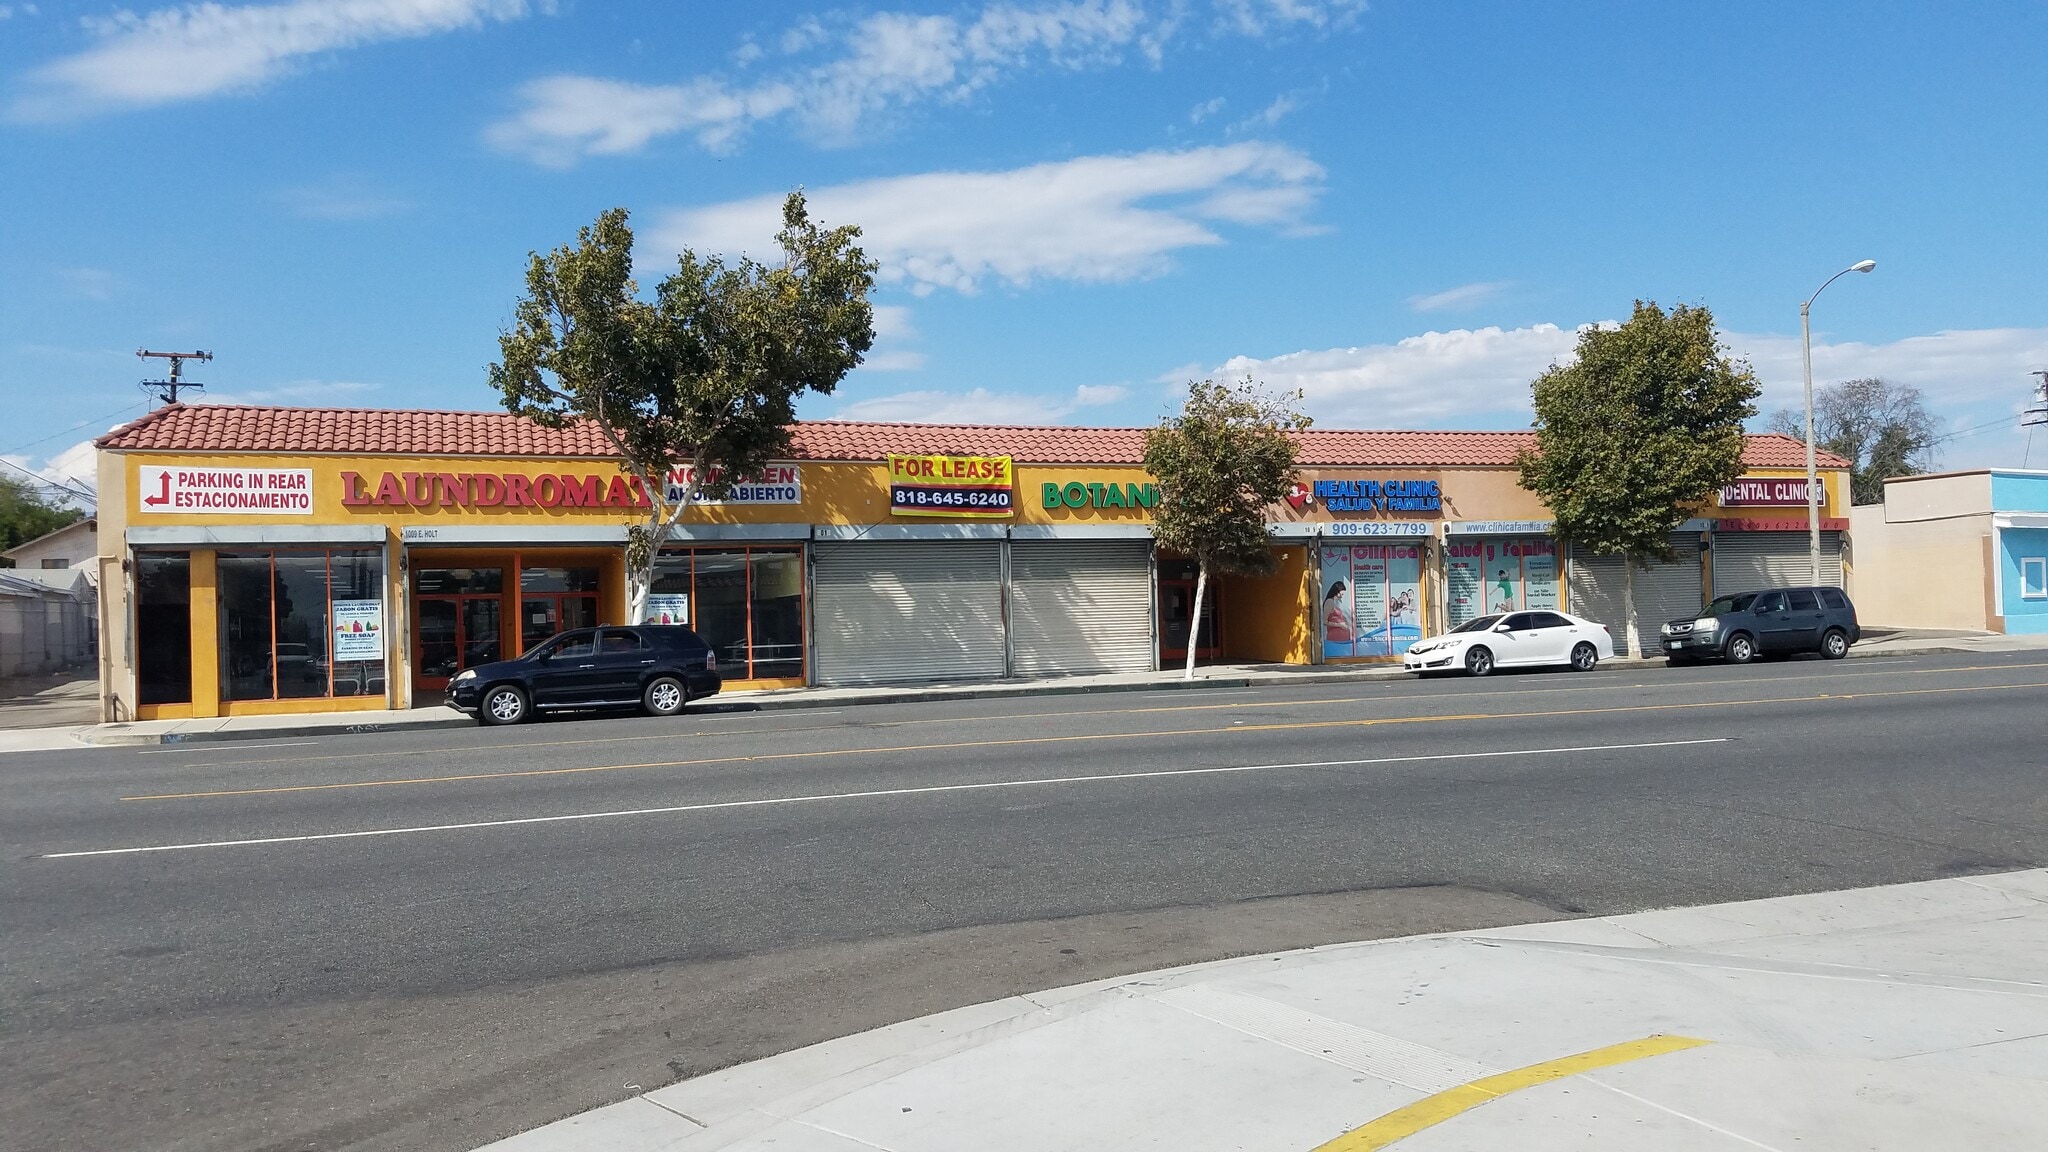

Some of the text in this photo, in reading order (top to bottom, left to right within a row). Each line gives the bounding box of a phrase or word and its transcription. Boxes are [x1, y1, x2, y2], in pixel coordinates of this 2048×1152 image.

[736, 468, 795, 484] EN
[893, 458, 1005, 479] FOR LEASE
[178, 472, 306, 490] PARKING IN REAR
[340, 471, 656, 508] LAUNDROMAT
[1314, 480, 1440, 498] HEALTH CLINIC
[175, 491, 309, 509] ESTACIONAMENTO
[729, 486, 796, 501] ABIERTO
[895, 489, 1009, 507] 818-645-6240
[1725, 483, 1771, 501] DENTAL
[1327, 498, 1441, 511] SALUD Y FAMILIA
[425, 529, 438, 538] HOLT
[1332, 523, 1427, 535] 909-623-7799
[1466, 522, 1554, 533] www.clinicafamilia.c
[1449, 541, 1482, 557] alud
